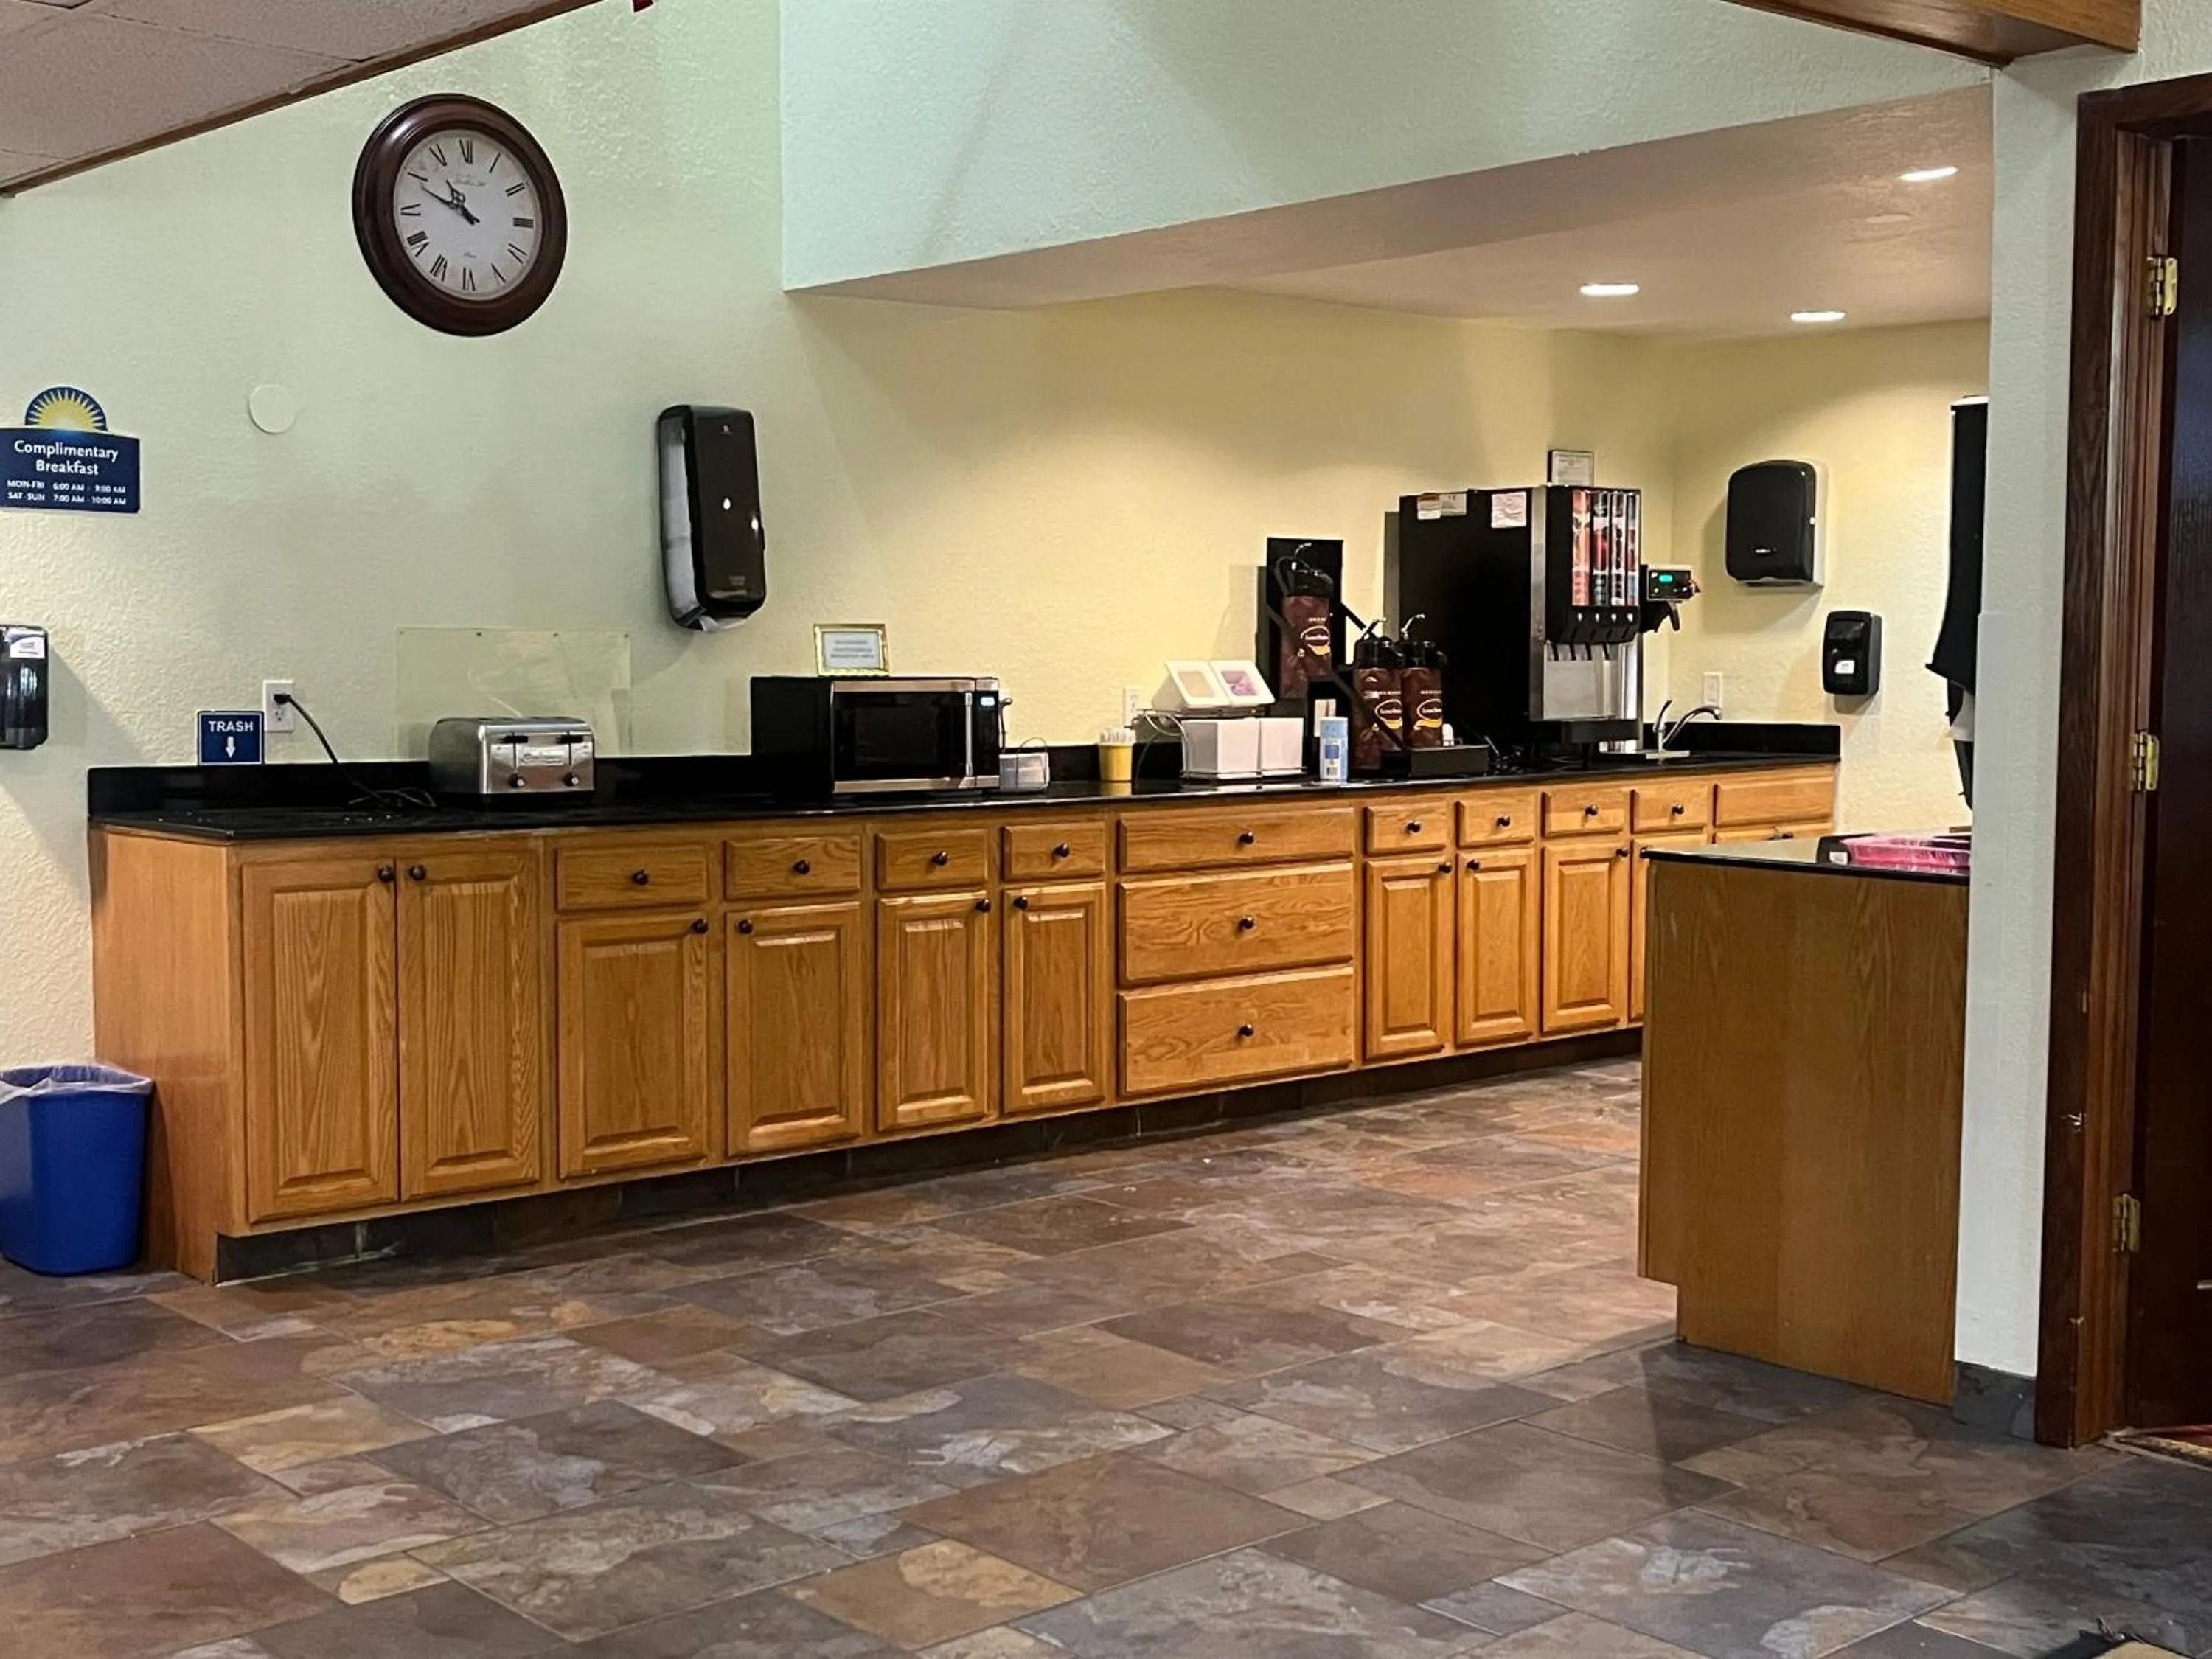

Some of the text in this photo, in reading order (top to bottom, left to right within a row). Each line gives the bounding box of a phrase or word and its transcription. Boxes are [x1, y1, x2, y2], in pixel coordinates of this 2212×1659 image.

[14, 440, 119, 462] Complimentary
[36, 459, 99, 476] Breakfast
[71, 483, 85, 492] AM
[113, 486, 126, 494] AM
[53, 493, 70, 503] 7:00
[72, 495, 85, 503] AM
[91, 496, 111, 505] 10:00
[113, 498, 126, 506] AM
[208, 720, 254, 733] TRASH
